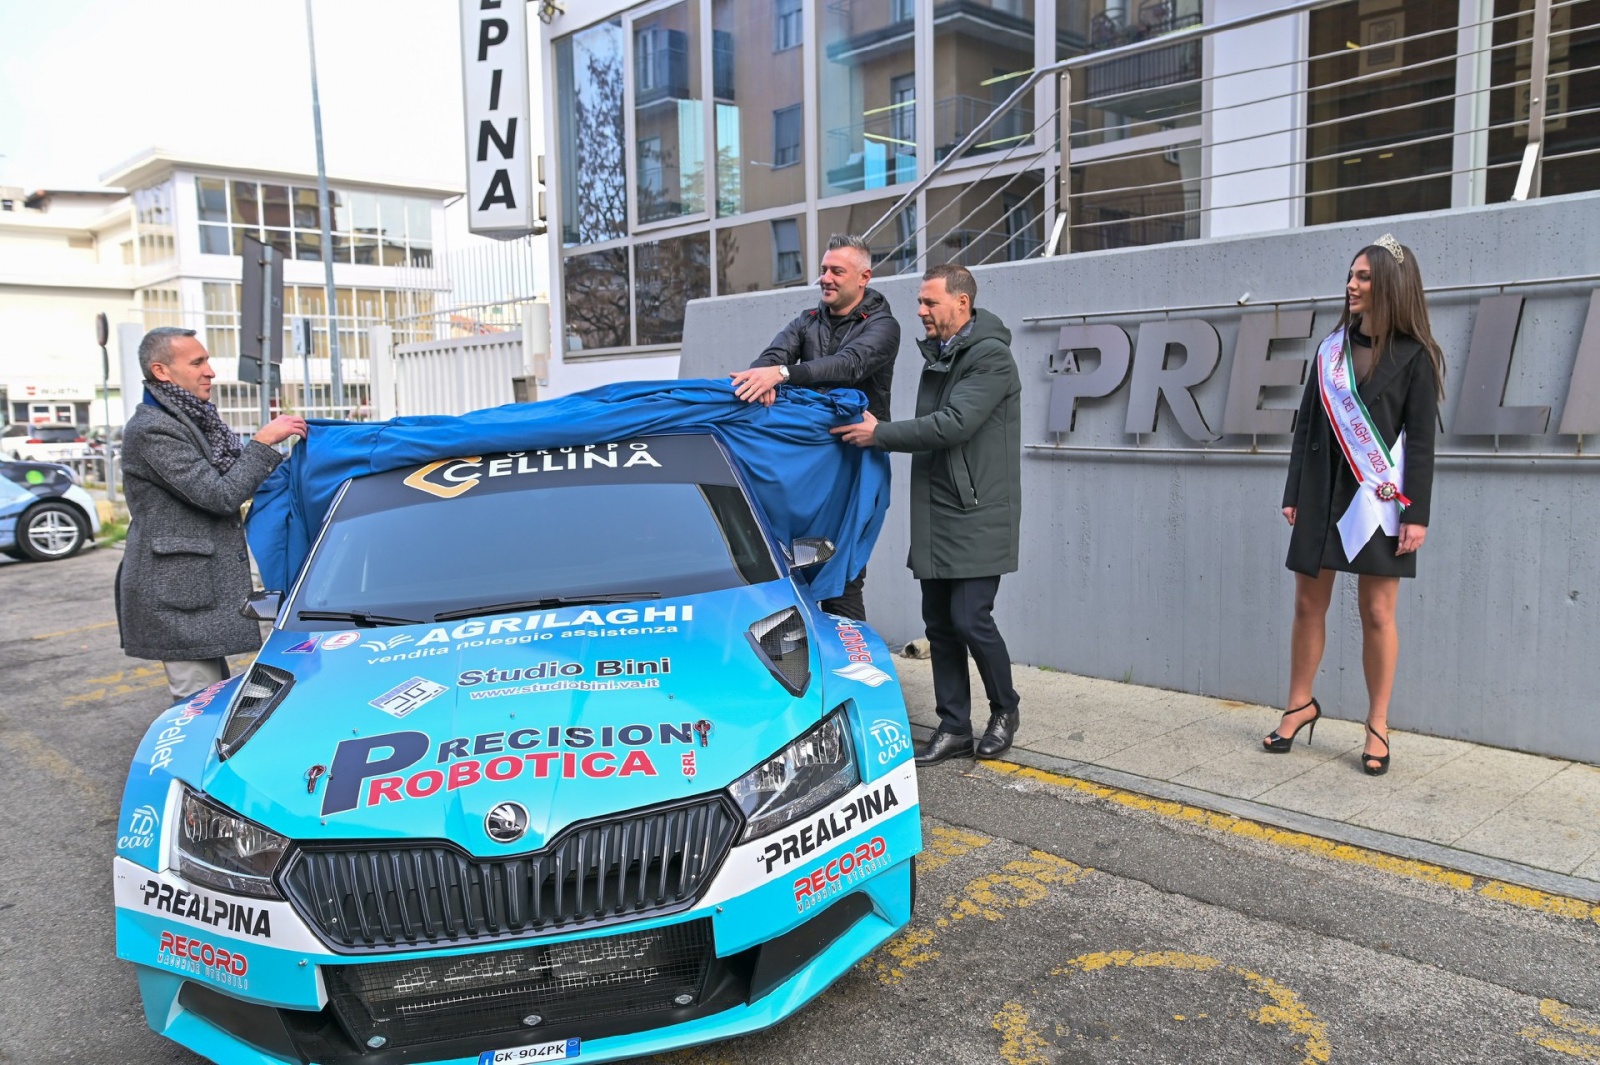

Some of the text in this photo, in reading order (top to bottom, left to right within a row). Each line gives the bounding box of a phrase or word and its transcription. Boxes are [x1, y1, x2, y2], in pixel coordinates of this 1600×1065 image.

[477, 0, 517, 211] PINA
[1045, 350, 1080, 374] LA
[1342, 396, 1355, 414] DEI
[1349, 416, 1372, 445] LAGHI
[1367, 449, 1387, 474] 2023
[443, 451, 662, 482] CELLINA
[367, 625, 678, 665] vendita noleggio assistenza
[414, 605, 693, 646] AGRILAGHI
[457, 657, 671, 687] Studio Bini
[470, 678, 660, 700] www.studiobini.va.it
[149, 715, 193, 776] pellet
[681, 750, 697, 778] SRL
[367, 750, 658, 807] ROBOTICA
[757, 784, 899, 874] LA PREALPINA
[793, 836, 887, 902] RECORD
[144, 880, 271, 938] PREALPINA
[158, 931, 249, 976] RECORD
